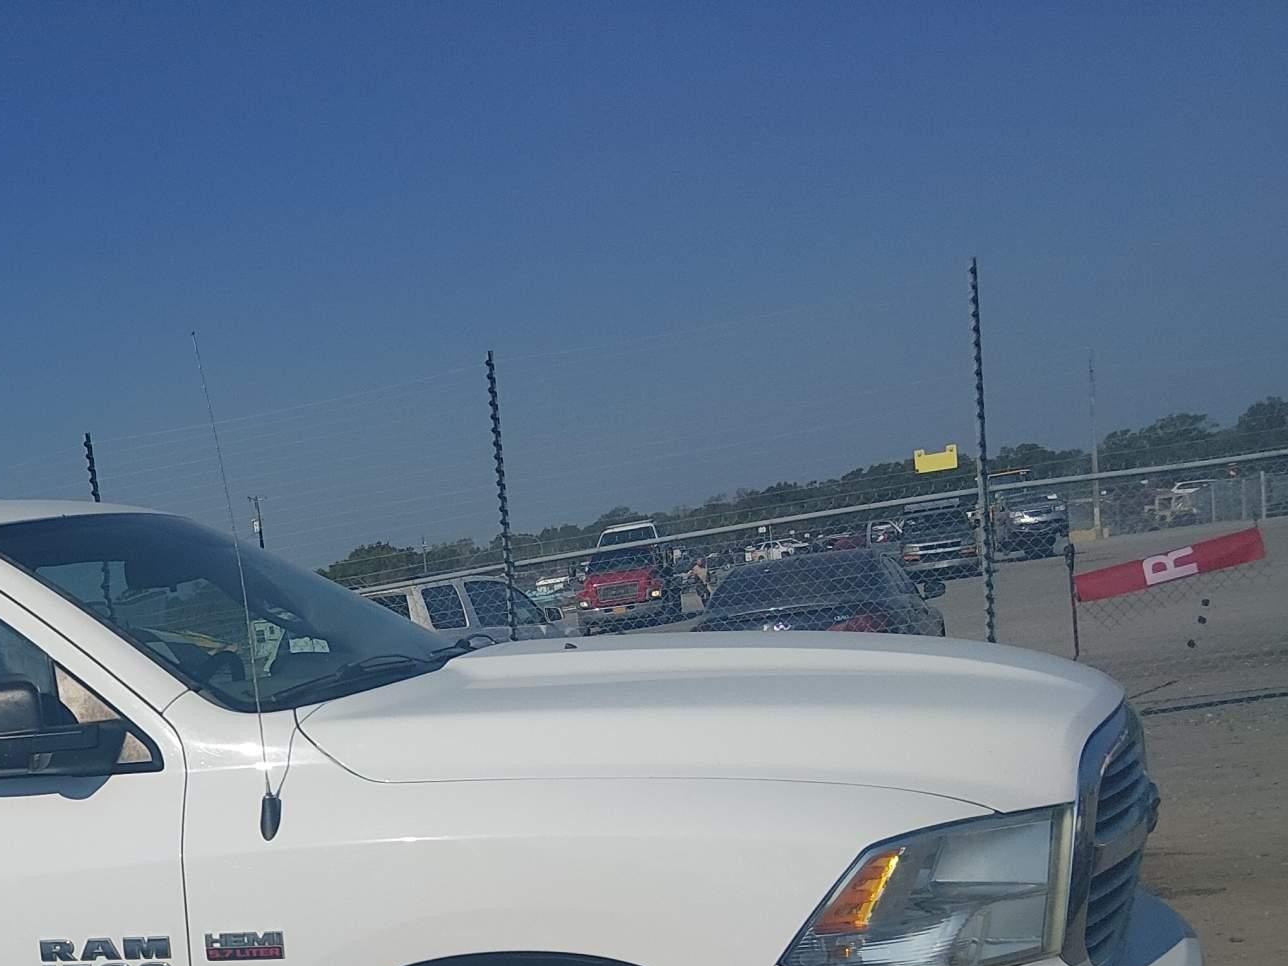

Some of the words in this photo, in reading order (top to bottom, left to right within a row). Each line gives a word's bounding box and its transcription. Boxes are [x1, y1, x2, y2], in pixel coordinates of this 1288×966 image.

[205, 931, 284, 947] HEMI
[39, 936, 172, 961] RAM
[235, 947, 281, 958] LITER
